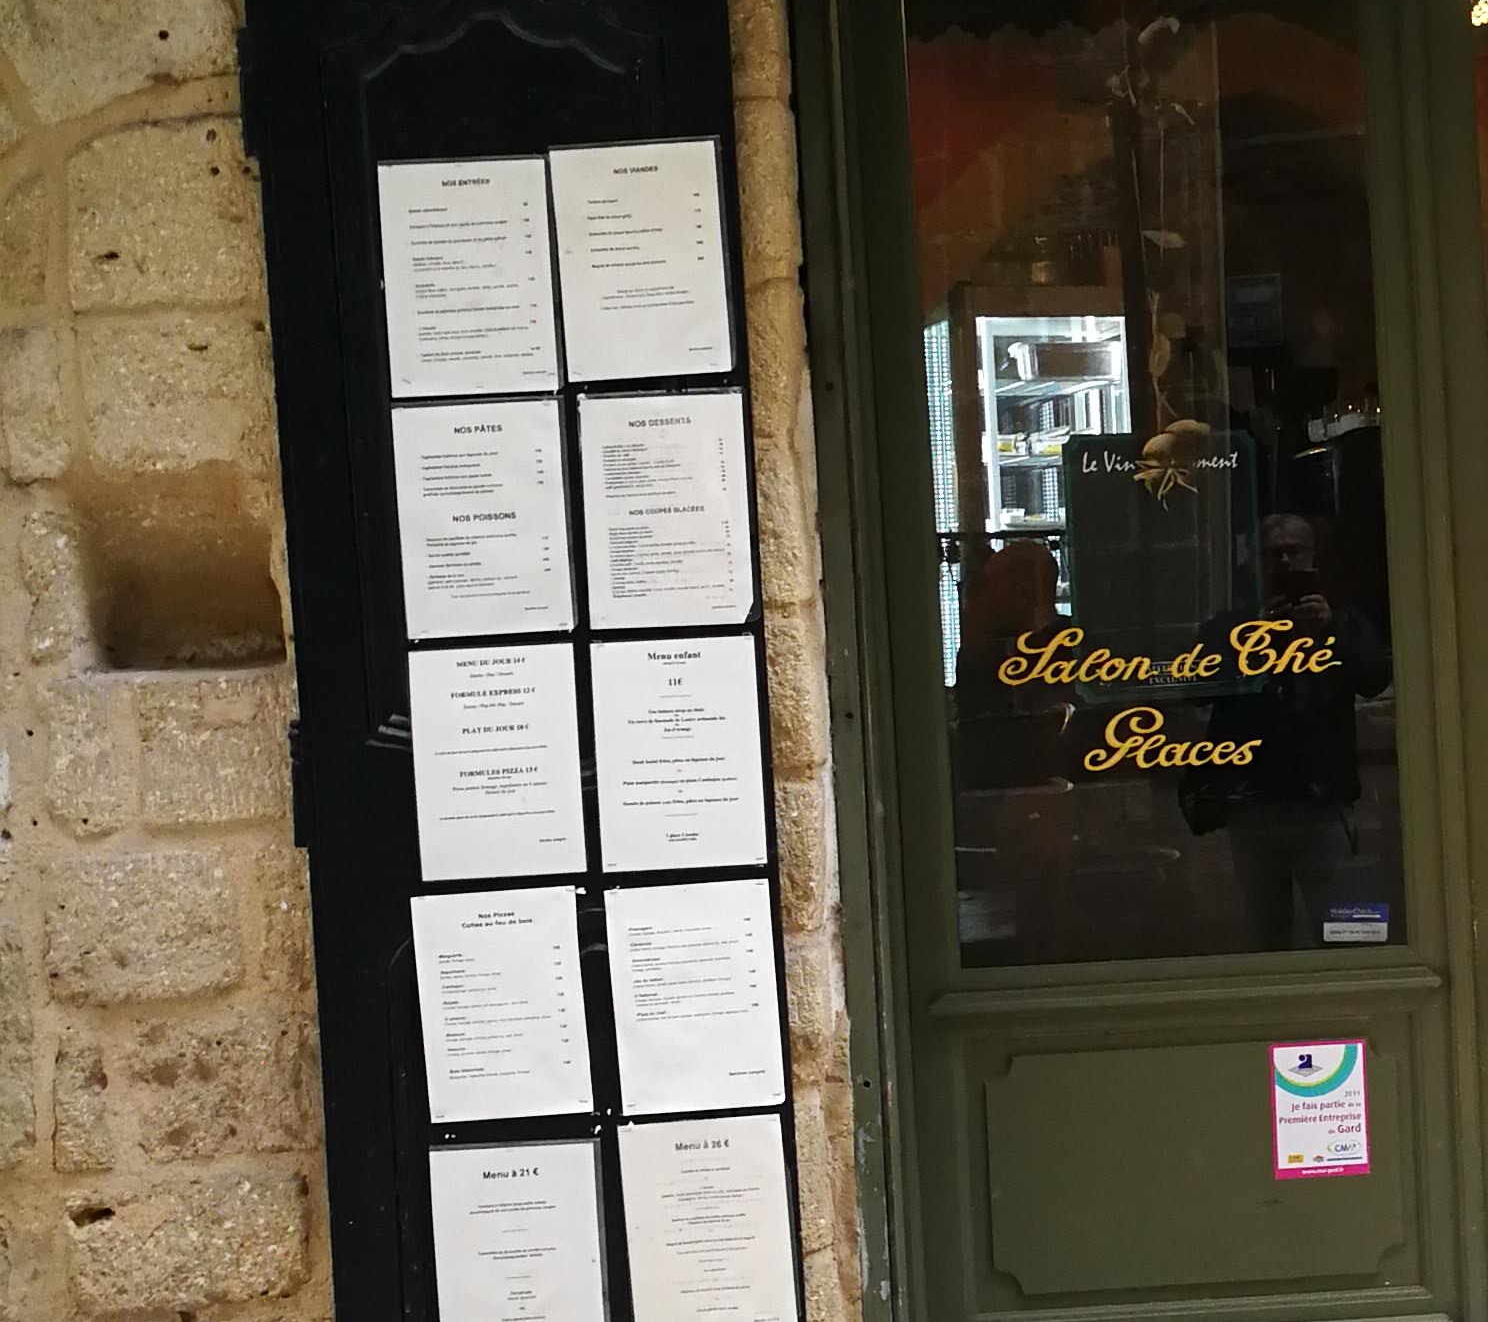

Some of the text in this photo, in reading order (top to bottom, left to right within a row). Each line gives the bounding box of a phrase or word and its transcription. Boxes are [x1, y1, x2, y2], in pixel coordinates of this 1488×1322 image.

[453, 424, 503, 435] NOS PÂTES
[1082, 451, 1098, 474] Le
[1103, 450, 1137, 473] Vin
[452, 512, 517, 523] NOS POISSONS
[648, 651, 701, 661] Menu enfant
[998, 619, 1342, 686] Salon de Thé
[456, 660, 478, 668] MENU
[479, 659, 490, 667] DU
[492, 658, 512, 666] JOUR
[668, 677, 683, 686] 11€
[451, 689, 487, 699] FORMULE
[488, 688, 522, 698] EXPRESS
[462, 727, 482, 735] PLAT
[495, 725, 515, 733] JOUR
[1083, 706, 1262, 772] Glaces
[459, 769, 500, 778] FORMULES
[502, 767, 524, 776] PIZZA
[1344, 1090, 1361, 1098] 2011
[1291, 1103, 1301, 1112] Je
[1302, 1101, 1318, 1110] fais
[1320, 1100, 1346, 1110] partie
[1279, 1112, 1362, 1125] Première Entreprise
[1337, 1123, 1361, 1133] Gard
[675, 1141, 701, 1151] Menu
[703, 1140, 709, 1149] à
[724, 1139, 730, 1148] €
[482, 1167, 539, 1179] Menu à 21 €
